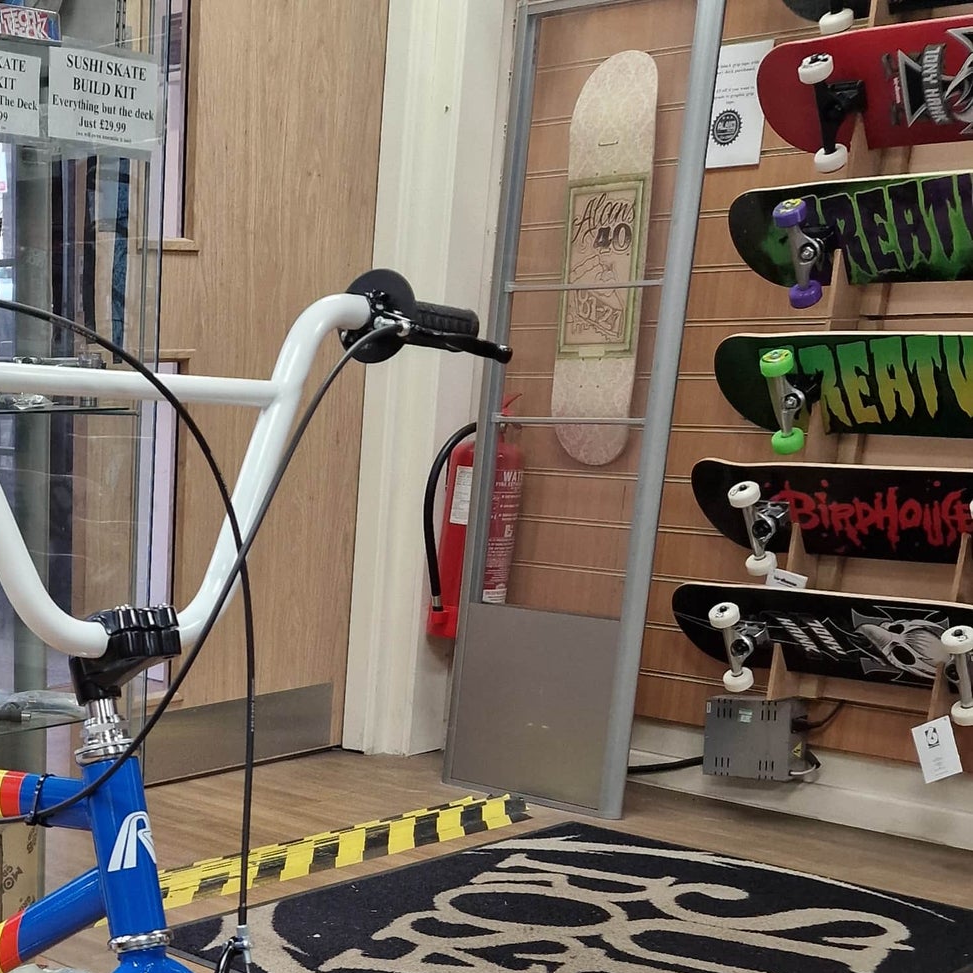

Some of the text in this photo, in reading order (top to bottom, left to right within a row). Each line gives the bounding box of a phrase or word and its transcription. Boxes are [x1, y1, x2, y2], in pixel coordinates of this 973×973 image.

[66, 54, 147, 82] SUSHI SKATE
[73, 77, 137, 101] BUILD KIT
[17, 98, 38, 111] Deck
[52, 94, 154, 121] Everything but the deck
[79, 116, 127, 133] Just £29.99
[593, 223, 632, 251] 40
[774, 484, 972, 547] BIRDHOUSE
